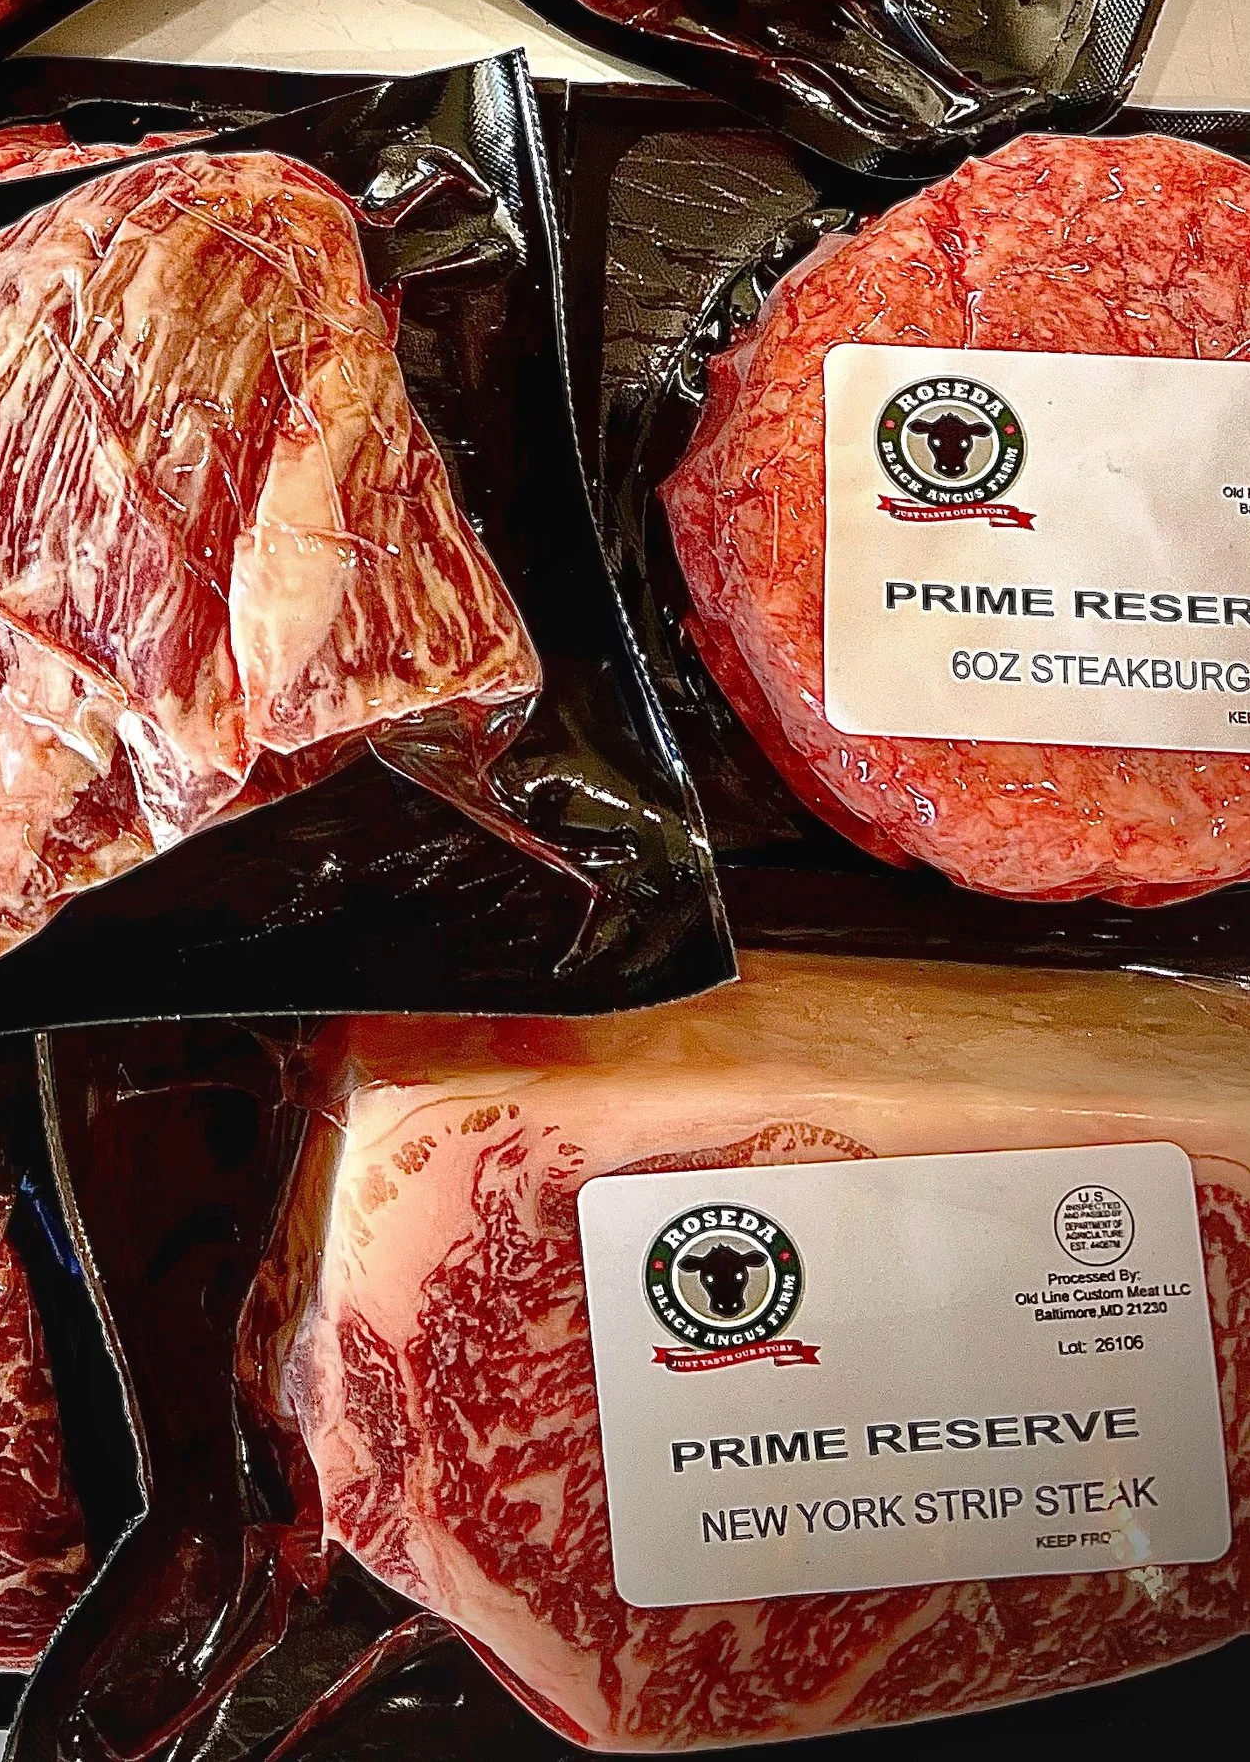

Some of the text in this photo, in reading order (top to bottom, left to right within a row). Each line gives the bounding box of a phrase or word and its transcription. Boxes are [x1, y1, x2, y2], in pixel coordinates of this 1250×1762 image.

[895, 382, 1004, 418] ROSEDA
[881, 441, 1018, 504] BLACK ANGUS FARM
[1222, 487, 1244, 499] Old
[886, 582, 1250, 626] PRIME RESER
[1030, 654, 1250, 693] STEAKBURG
[663, 1209, 777, 1249] ROSEDA
[1015, 1283, 1191, 1305] Old Line Custom Meat LLC
[1048, 1269, 1141, 1286] Processed By:
[652, 1274, 796, 1346] BLACK ANGUS FARM
[1127, 1301, 1167, 1315] 21230
[1095, 1335, 1143, 1353] 26106
[672, 1408, 1139, 1472] PRIME RESERVE
[702, 1476, 1158, 1542] NEW YORK STRIP STEAK
[1036, 1535, 1076, 1548] KEEP
